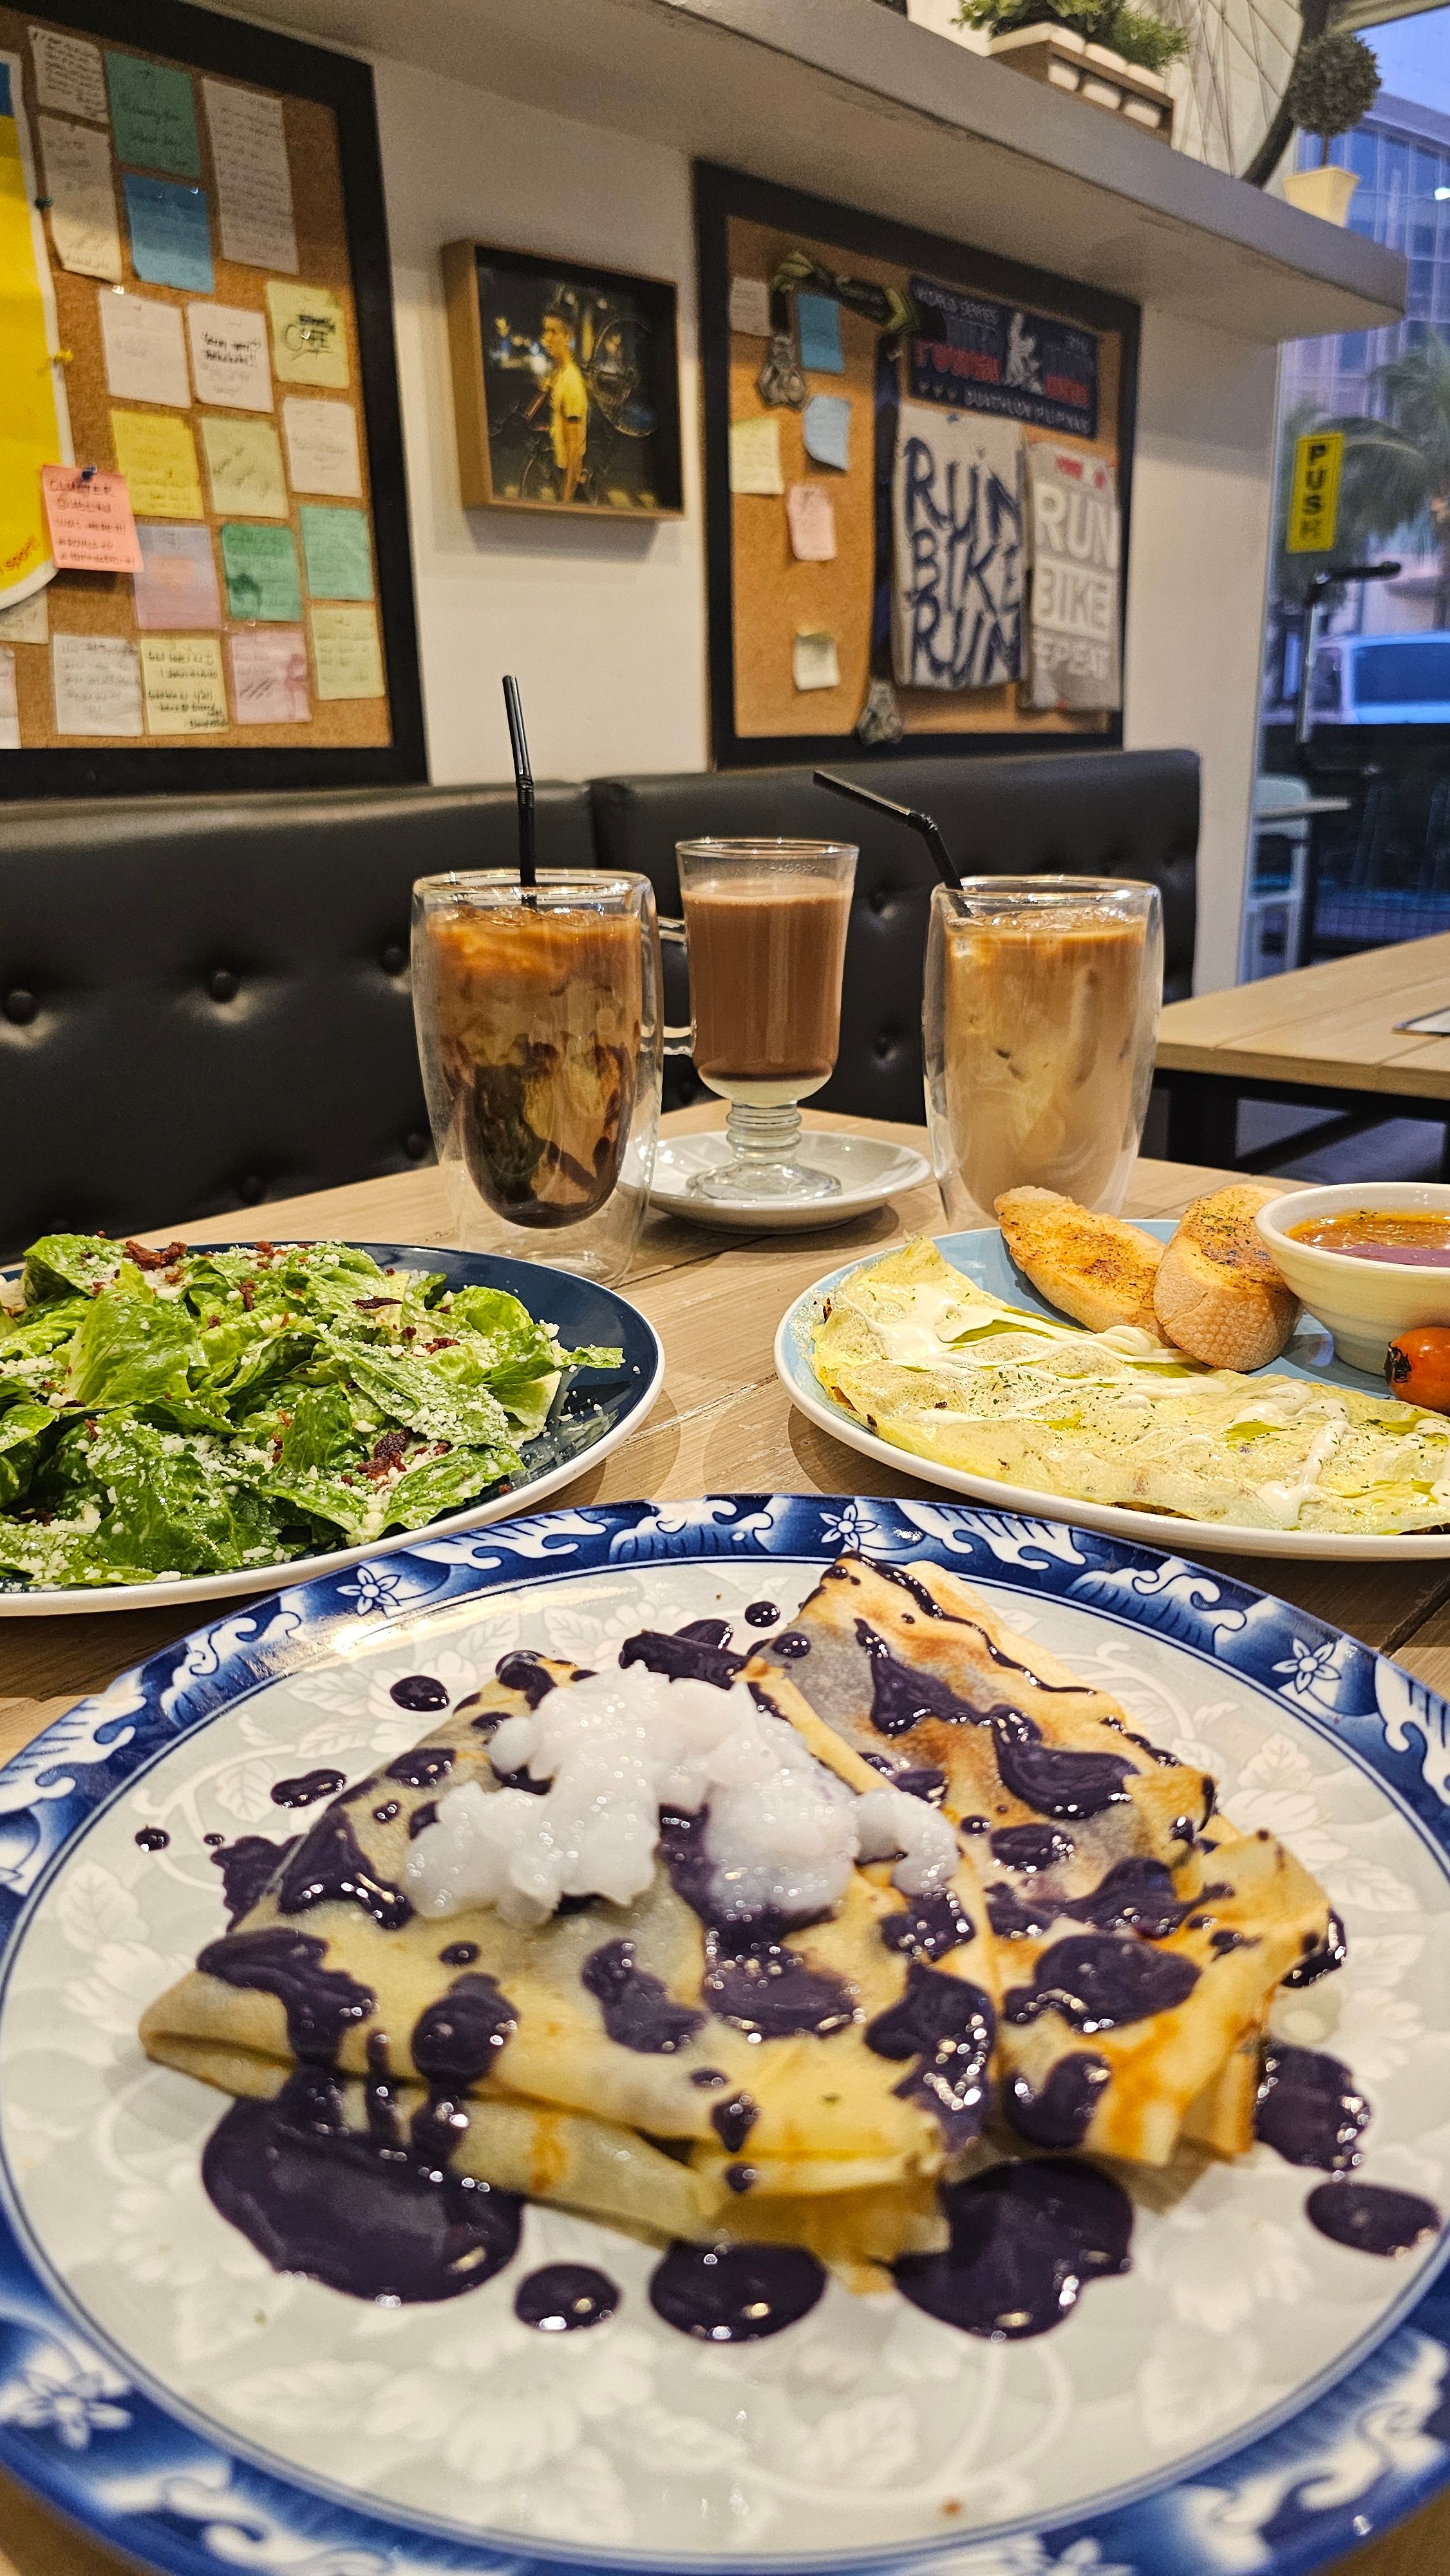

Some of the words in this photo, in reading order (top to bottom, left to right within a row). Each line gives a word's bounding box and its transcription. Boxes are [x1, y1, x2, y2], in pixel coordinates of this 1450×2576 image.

[905, 437, 1022, 540] RUN
[1035, 482, 1119, 569] RUN
[1299, 444, 1328, 540] PUSH
[910, 528, 1021, 616] BIKE
[1038, 567, 1111, 634] BIKE
[910, 591, 1021, 686] RUN
[1033, 630, 1111, 681] EPEAT
